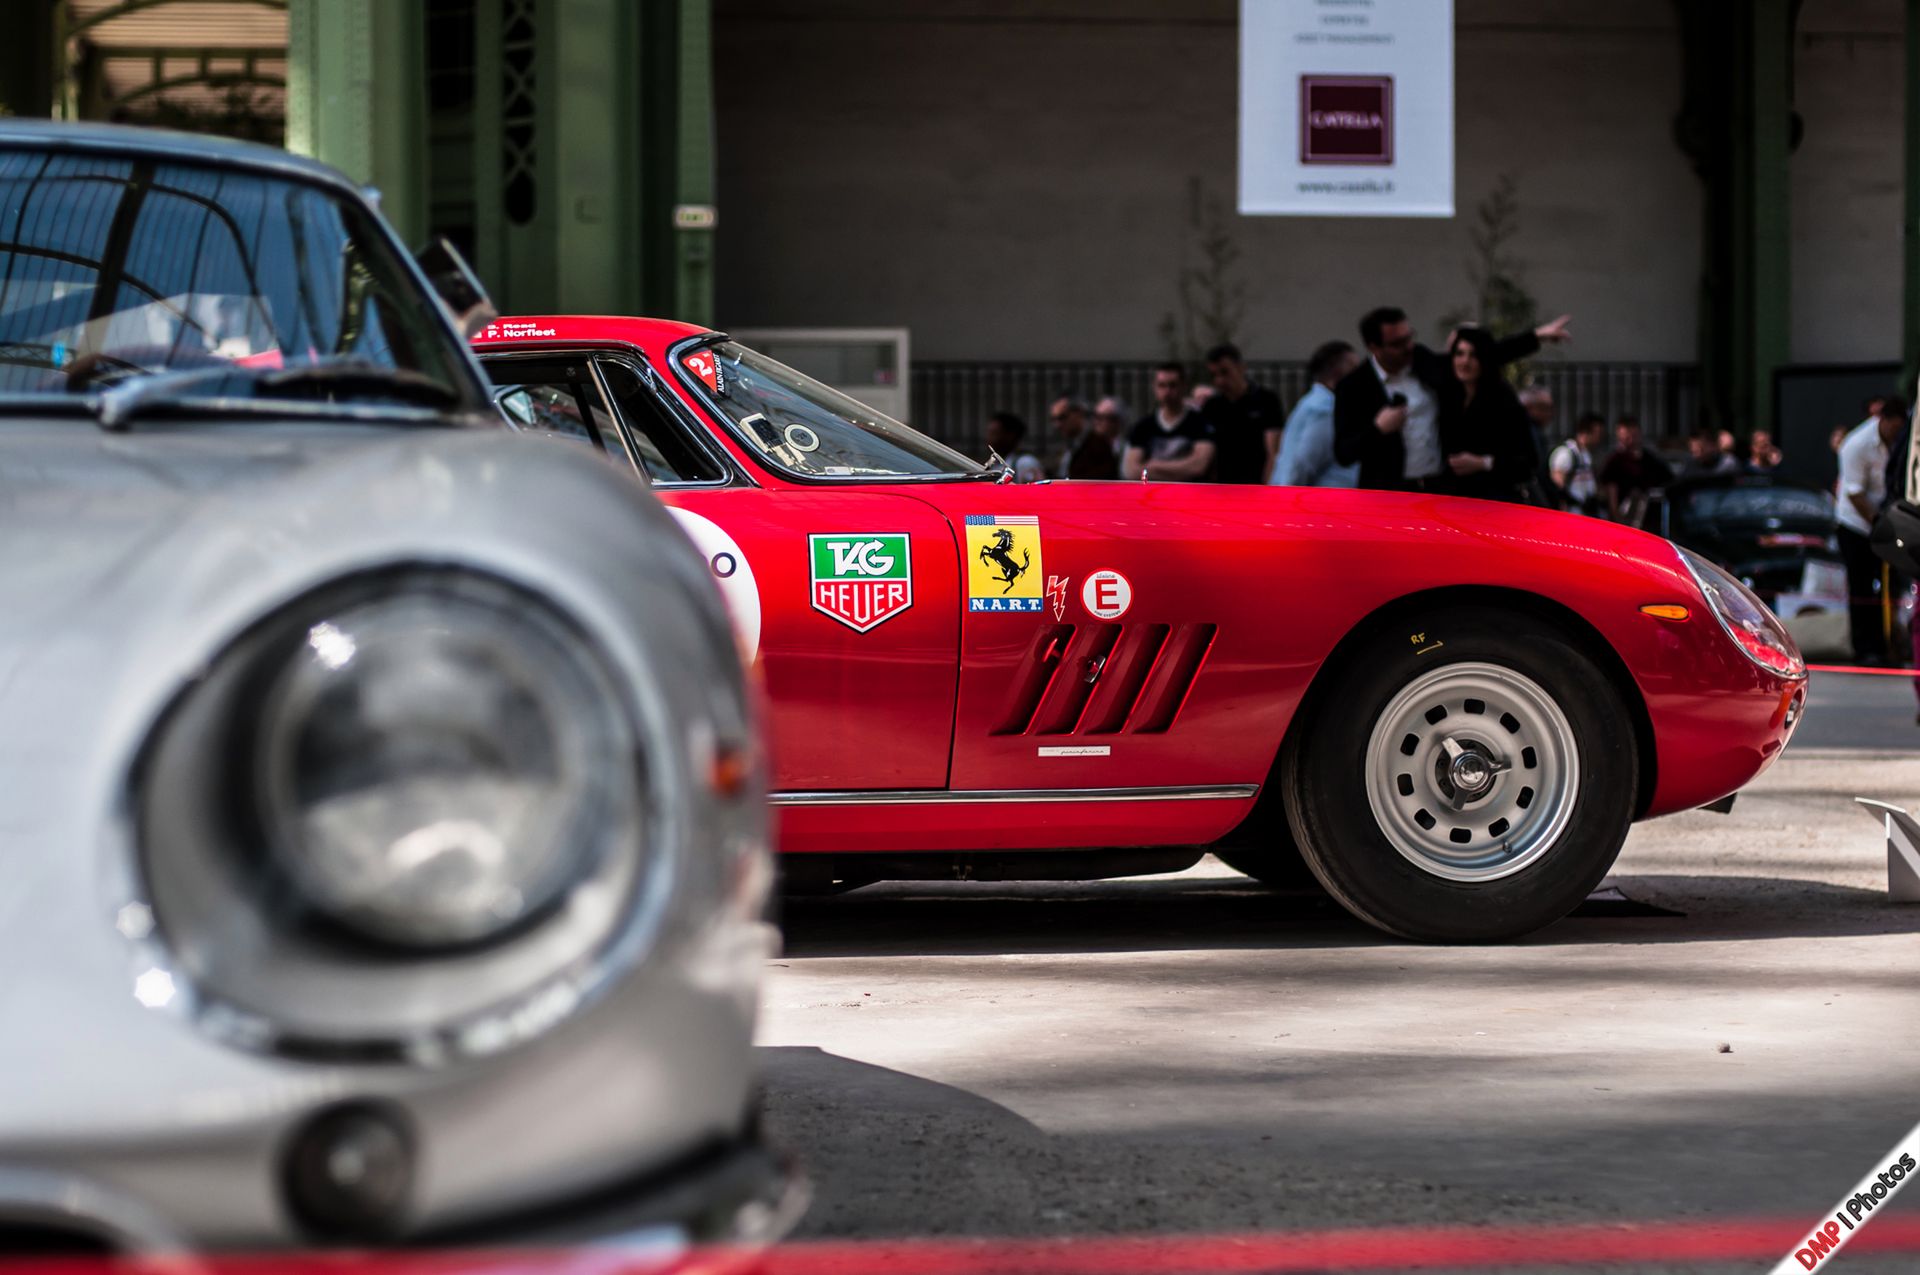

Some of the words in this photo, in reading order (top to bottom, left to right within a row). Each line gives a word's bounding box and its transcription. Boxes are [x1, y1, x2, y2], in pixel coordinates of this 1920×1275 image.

[488, 330, 500, 338] P.
[503, 328, 556, 337] Norfleet
[826, 538, 895, 576] TAG
[820, 584, 904, 623] HEUER
[1095, 579, 1120, 610] E
[1410, 632, 1425, 645] RF
